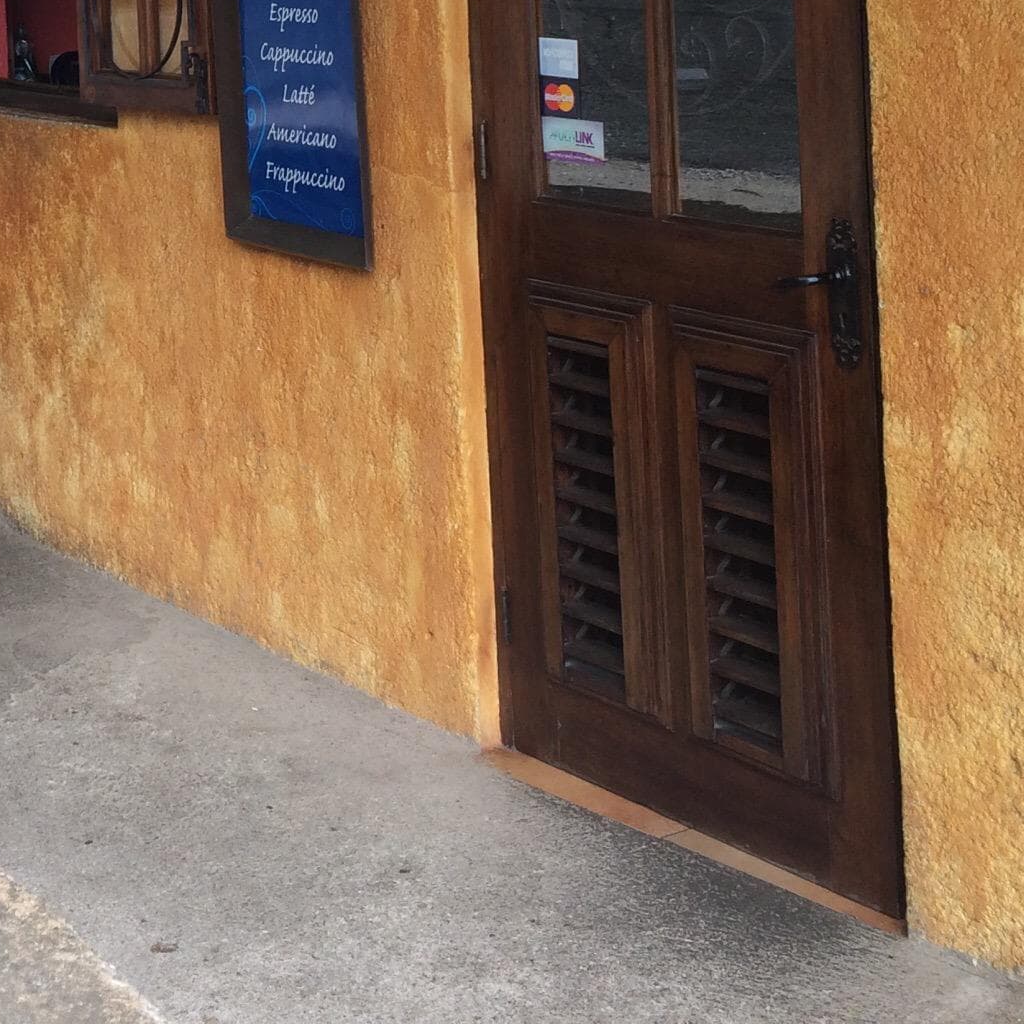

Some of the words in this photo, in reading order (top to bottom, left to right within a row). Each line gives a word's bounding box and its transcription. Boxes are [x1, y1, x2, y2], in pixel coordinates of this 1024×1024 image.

[269, 3, 319, 32] Espresso
[260, 42, 335, 72] Cappuccino
[282, 84, 316, 105] Latté
[267, 122, 337, 149] Americano
[266, 161, 346, 193] Frappuccino
